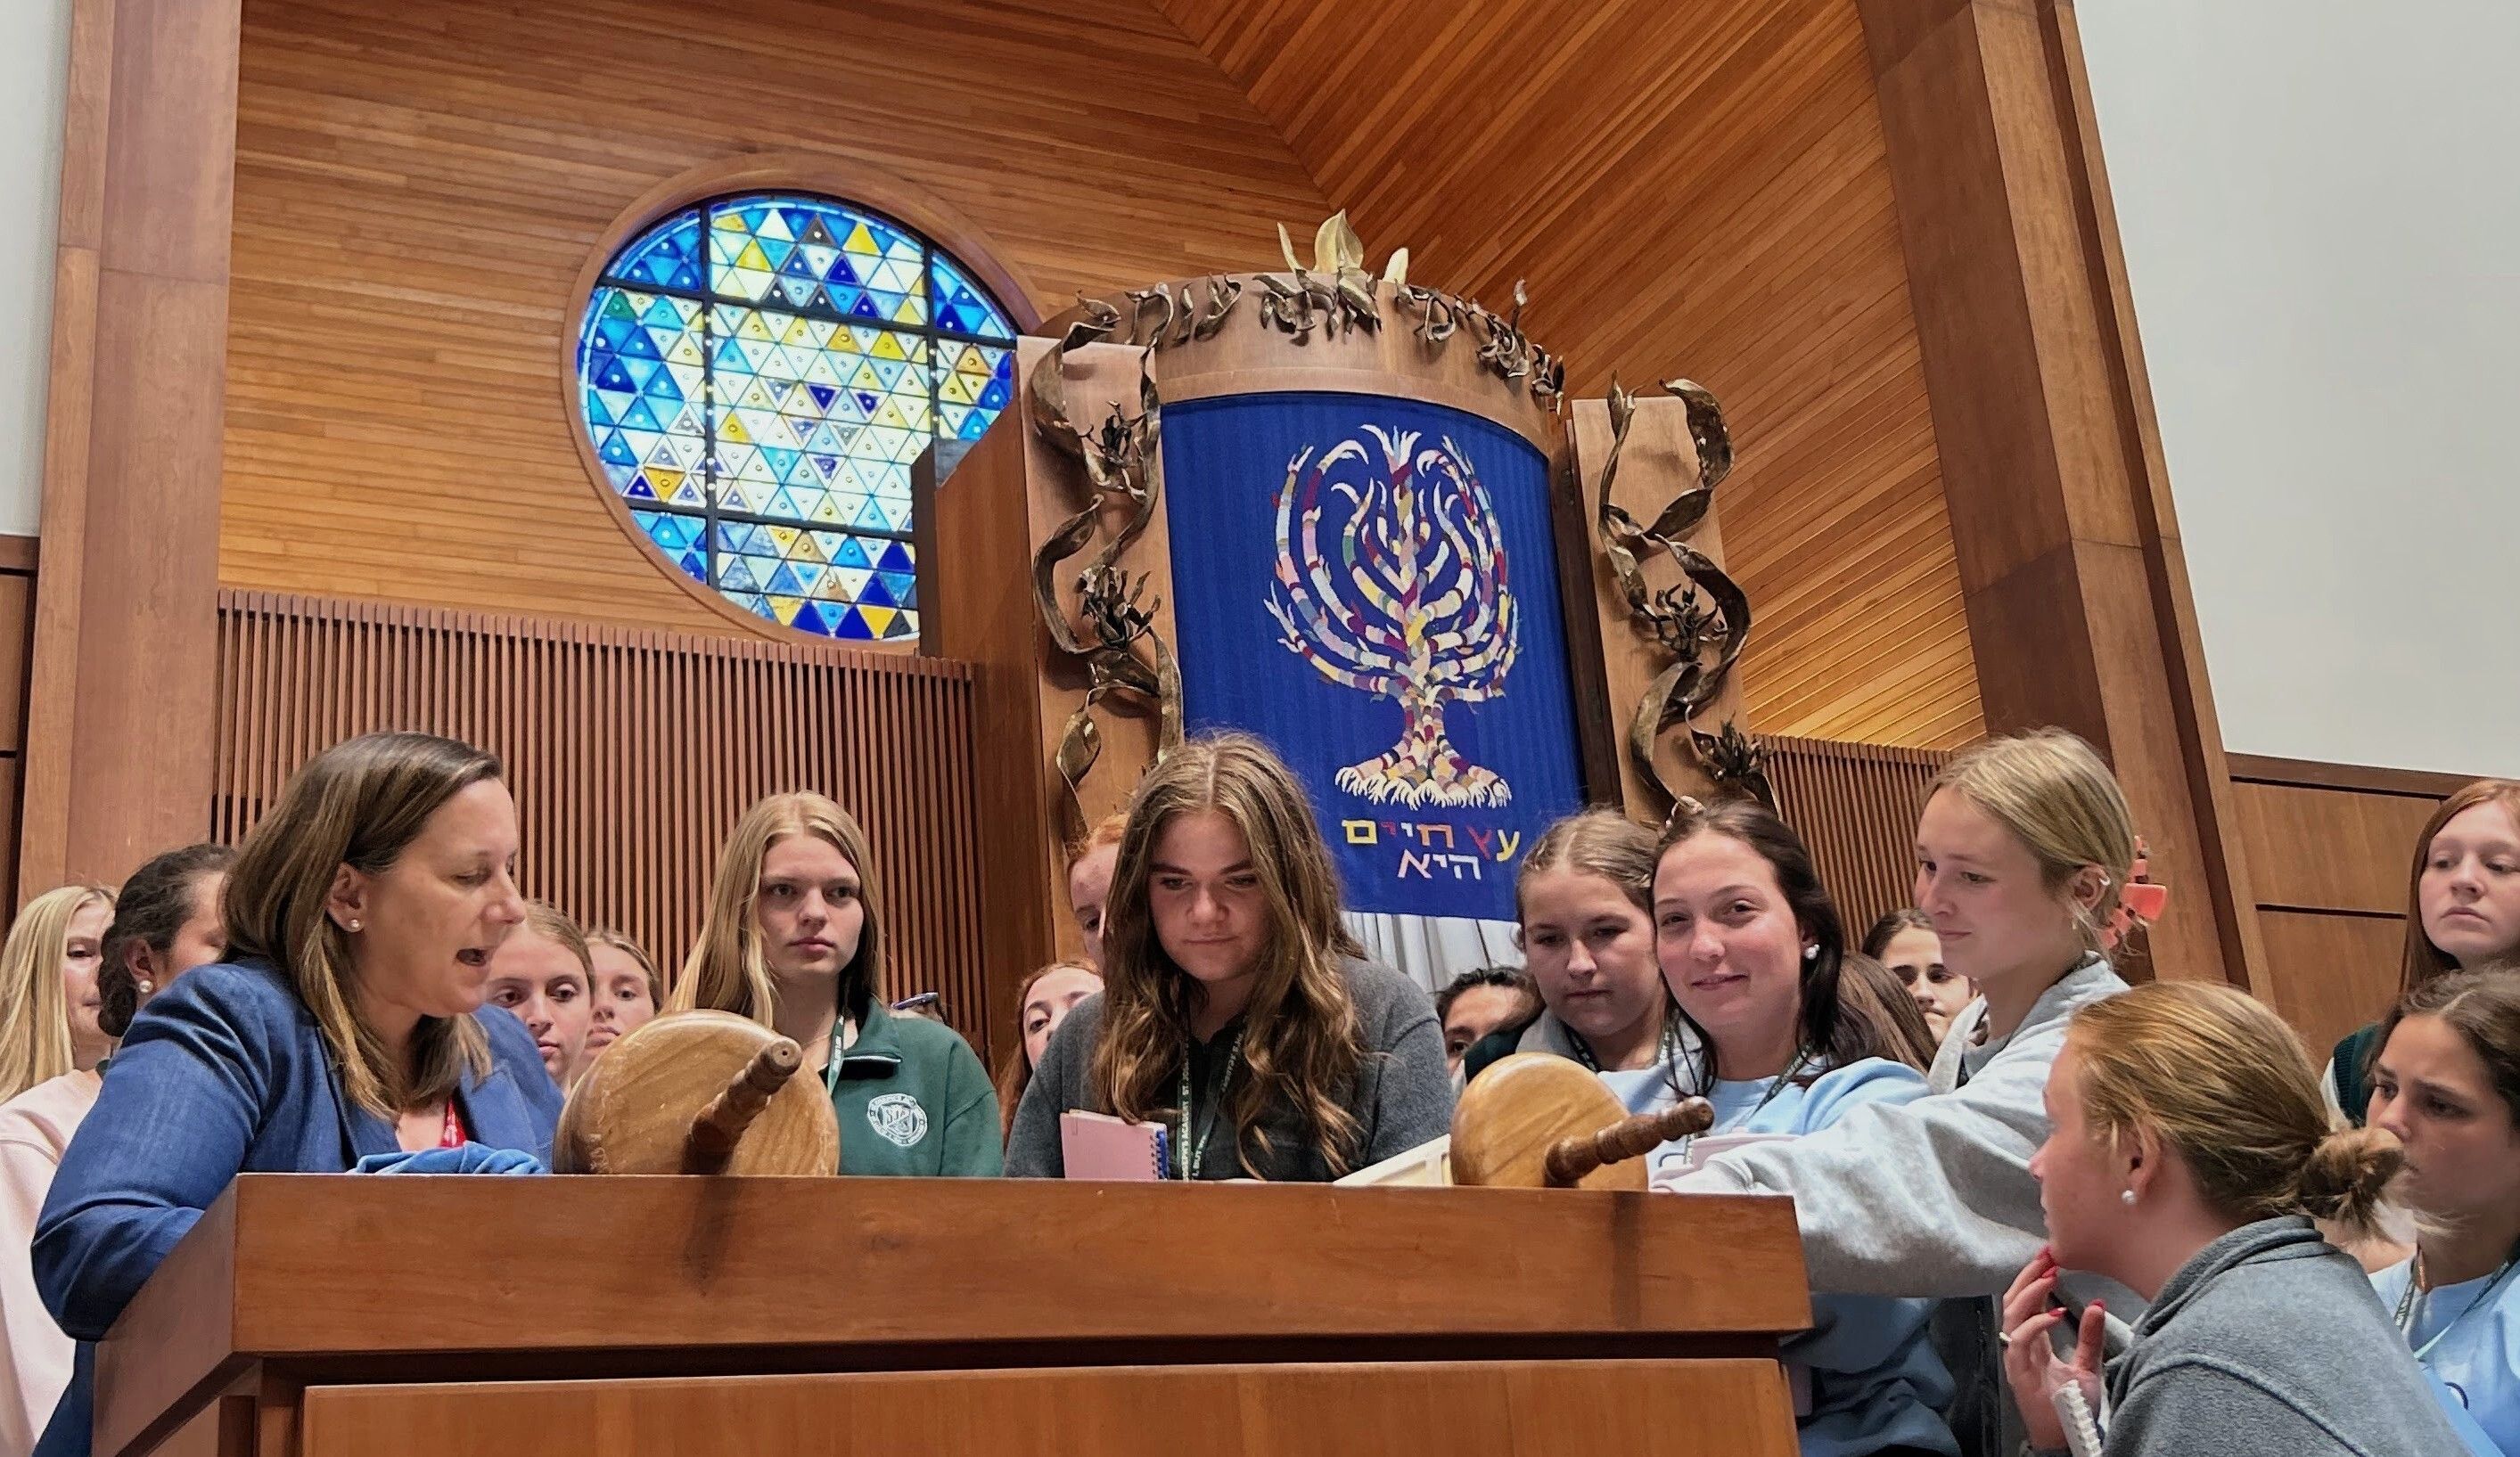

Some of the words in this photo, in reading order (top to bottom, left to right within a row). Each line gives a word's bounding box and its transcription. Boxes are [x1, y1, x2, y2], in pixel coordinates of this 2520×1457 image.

[1342, 820, 1455, 848] חיים
[1467, 827, 1520, 862] עץ
[1397, 848, 1482, 880] היא
